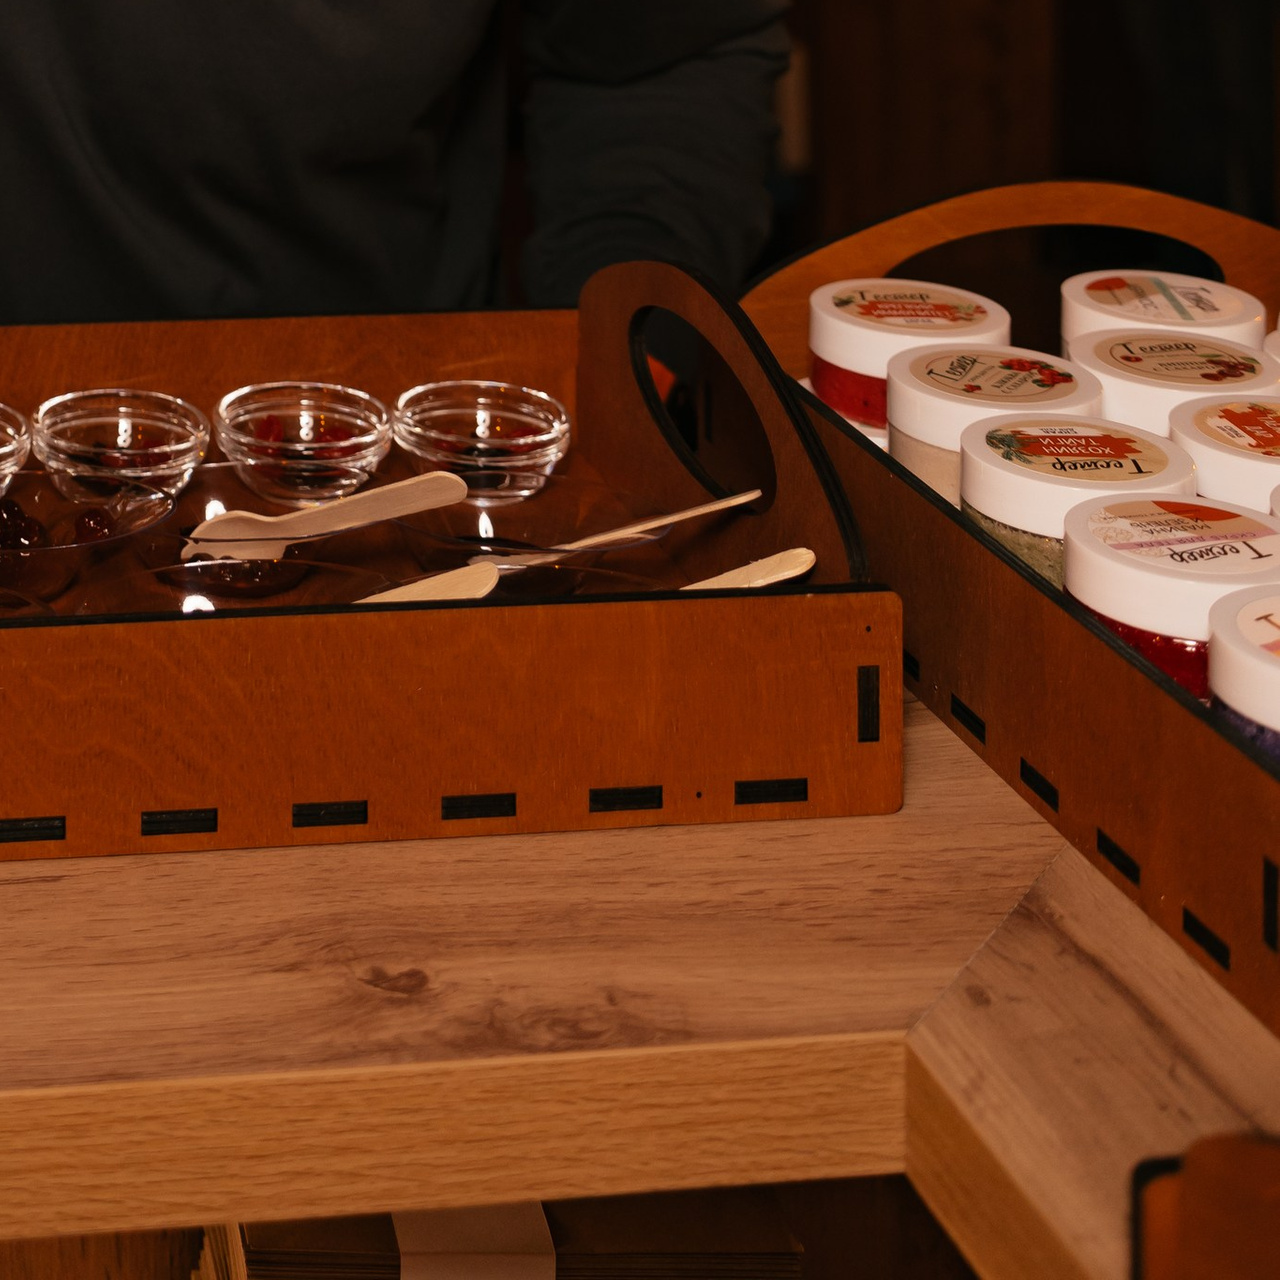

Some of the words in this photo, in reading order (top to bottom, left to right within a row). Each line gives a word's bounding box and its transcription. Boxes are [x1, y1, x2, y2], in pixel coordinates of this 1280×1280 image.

[1038, 437, 1099, 446] ТАЙГИ
[1041, 445, 1115, 455] ХОЗЯИН
[1051, 457, 1153, 475] Тестер
[1142, 523, 1213, 536] МАЛИНА
[1166, 540, 1273, 564] Тестер
